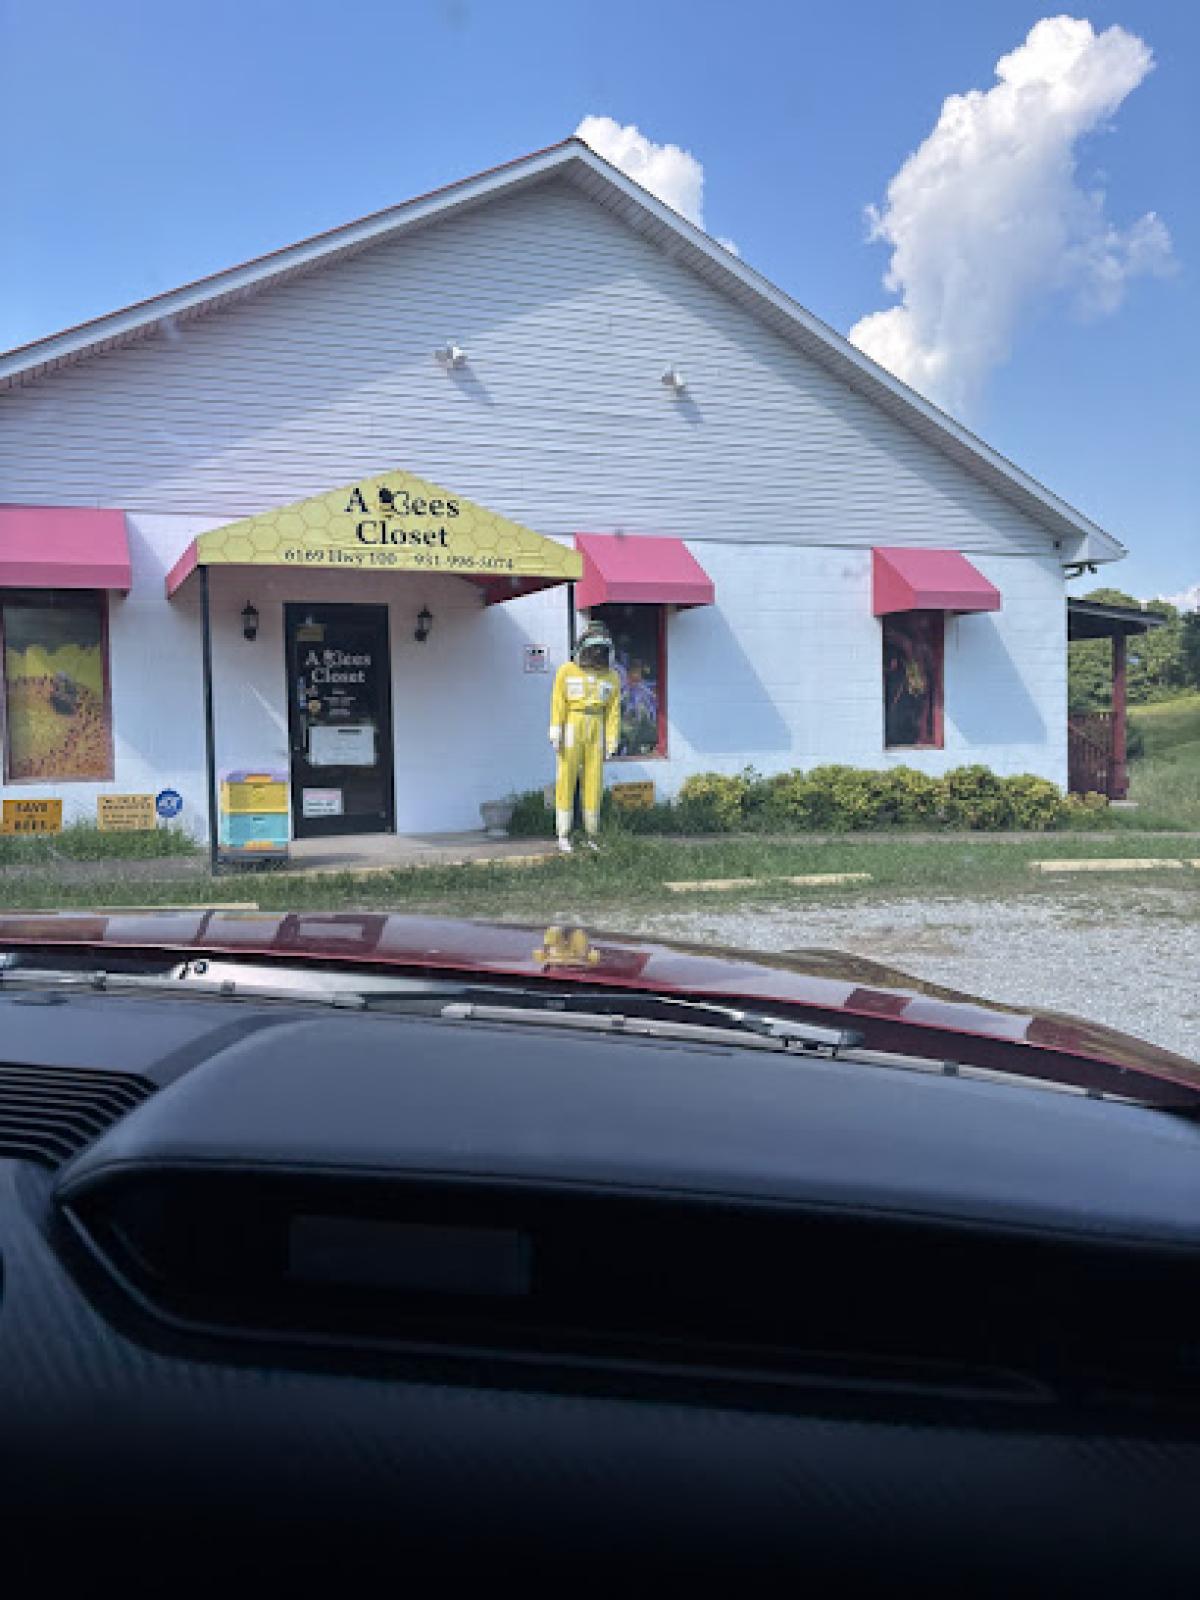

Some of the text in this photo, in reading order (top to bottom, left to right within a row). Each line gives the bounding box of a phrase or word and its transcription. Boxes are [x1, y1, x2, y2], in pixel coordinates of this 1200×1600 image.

[344, 487, 369, 514] A
[356, 520, 448, 547] Closet
[328, 549, 365, 566] Hwy
[311, 667, 366, 683] Closet
